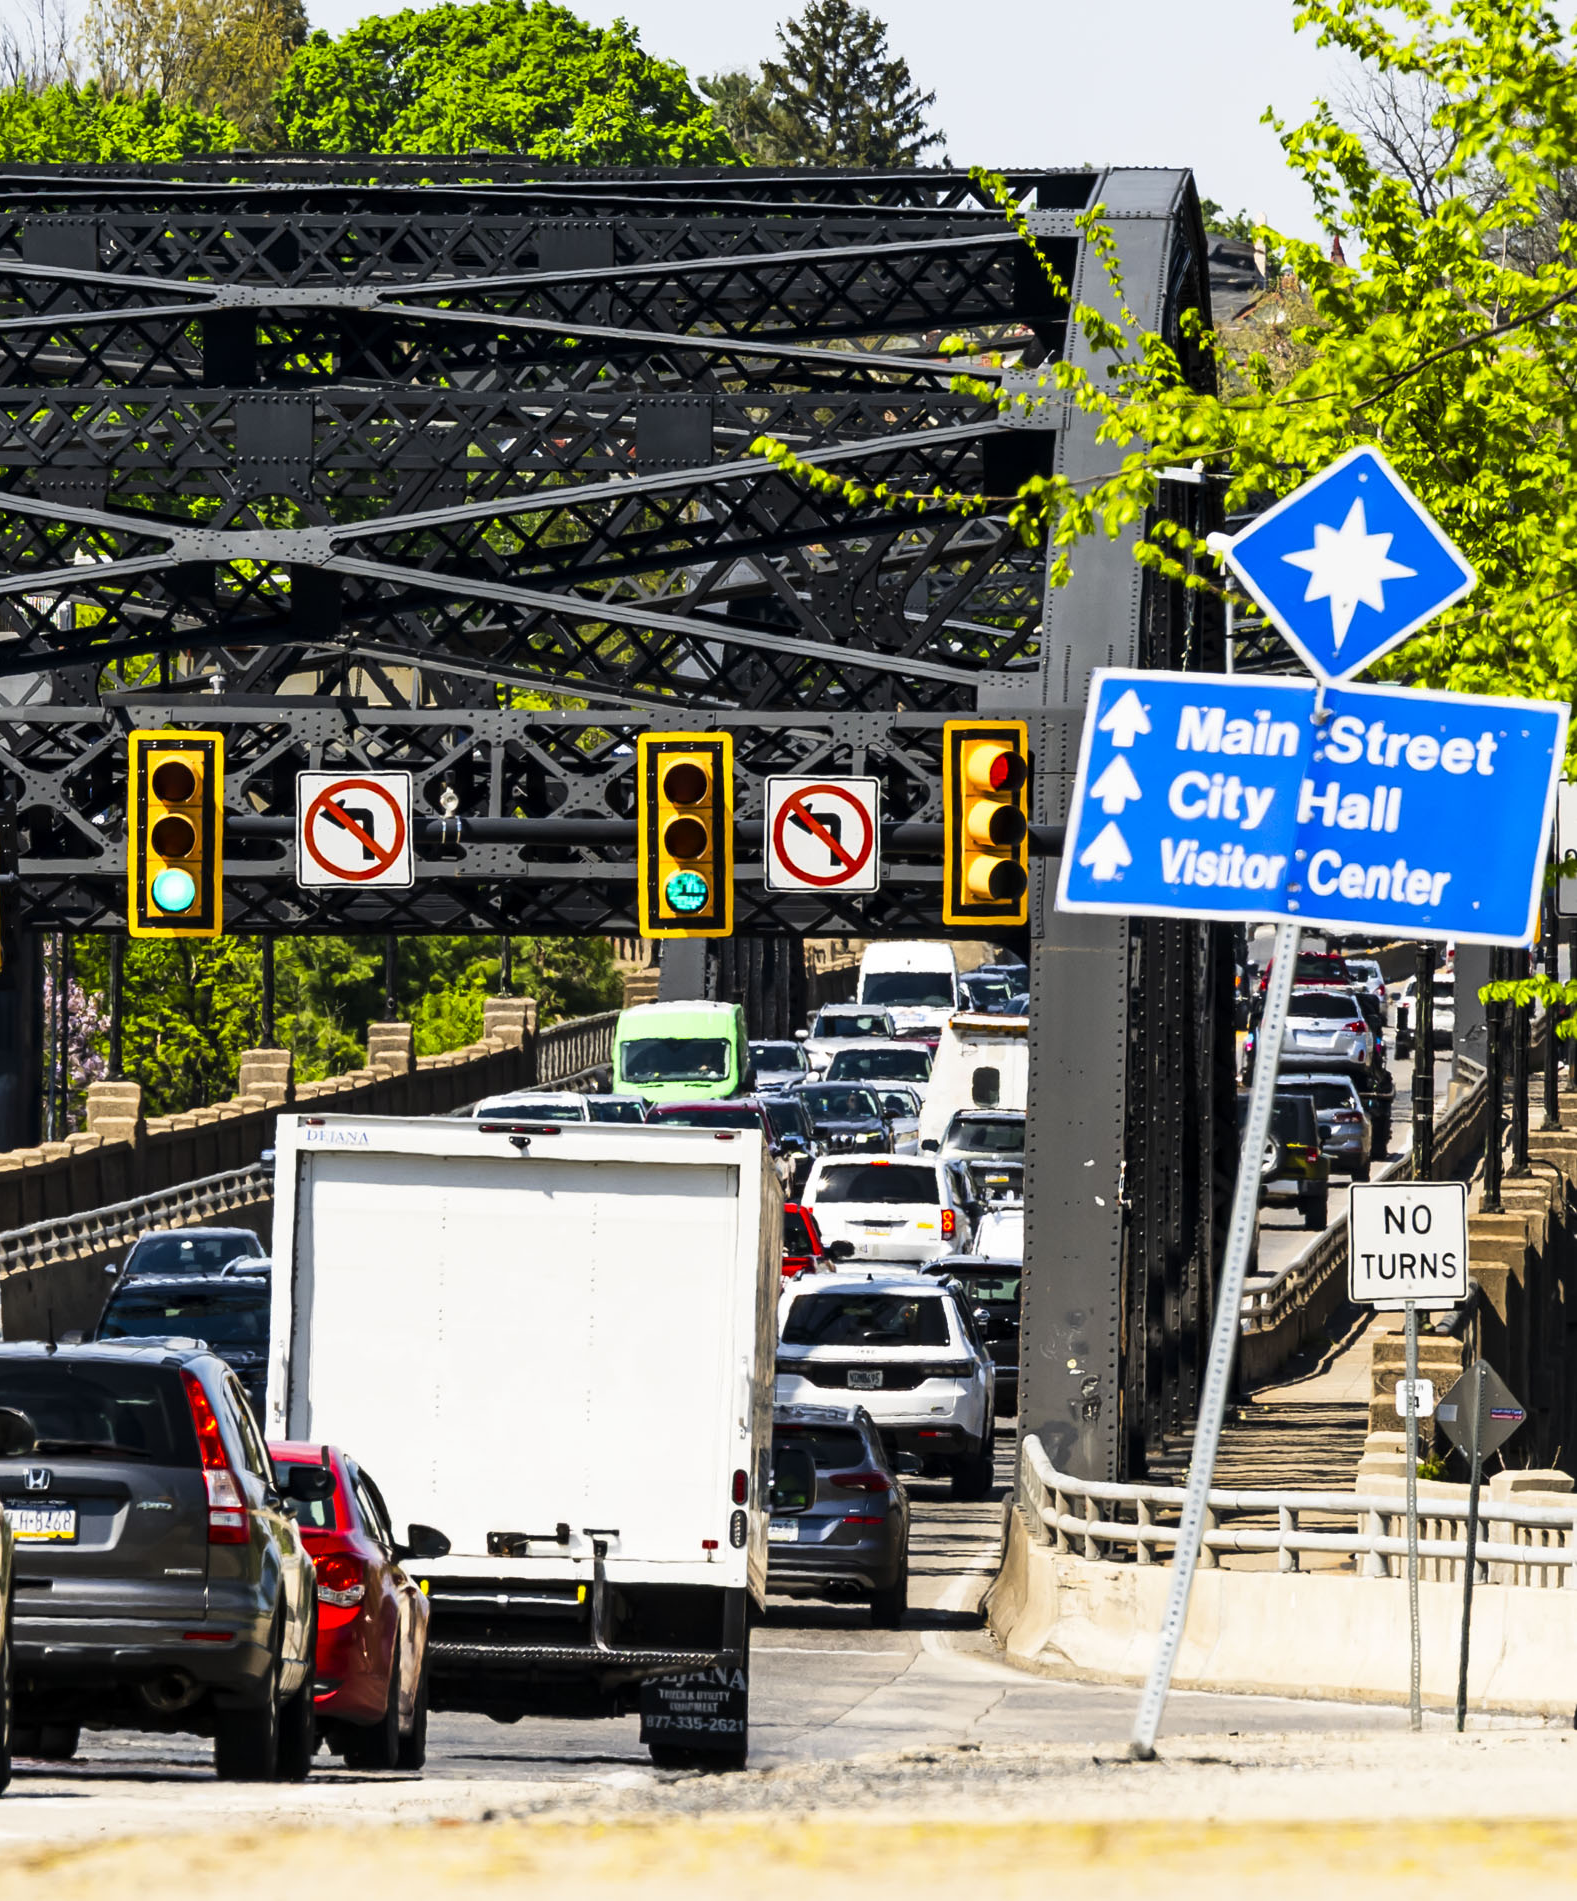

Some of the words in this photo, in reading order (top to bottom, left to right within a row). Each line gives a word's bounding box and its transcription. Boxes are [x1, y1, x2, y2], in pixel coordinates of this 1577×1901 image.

[1175, 705, 1299, 758] Main
[1324, 714, 1499, 776] Street
[1168, 770, 1275, 830] City
[1297, 779, 1402, 833] Hall
[1160, 837, 1287, 890] Visitor
[1307, 848, 1452, 907] Center
[1384, 1204, 1432, 1235] NO
[1361, 1252, 1457, 1280] TURNS
[670, 1701, 719, 1713] EQUIPMENT
[697, 1690, 730, 1702] UTILITY
[646, 1715, 744, 1732] 877-335-2621
